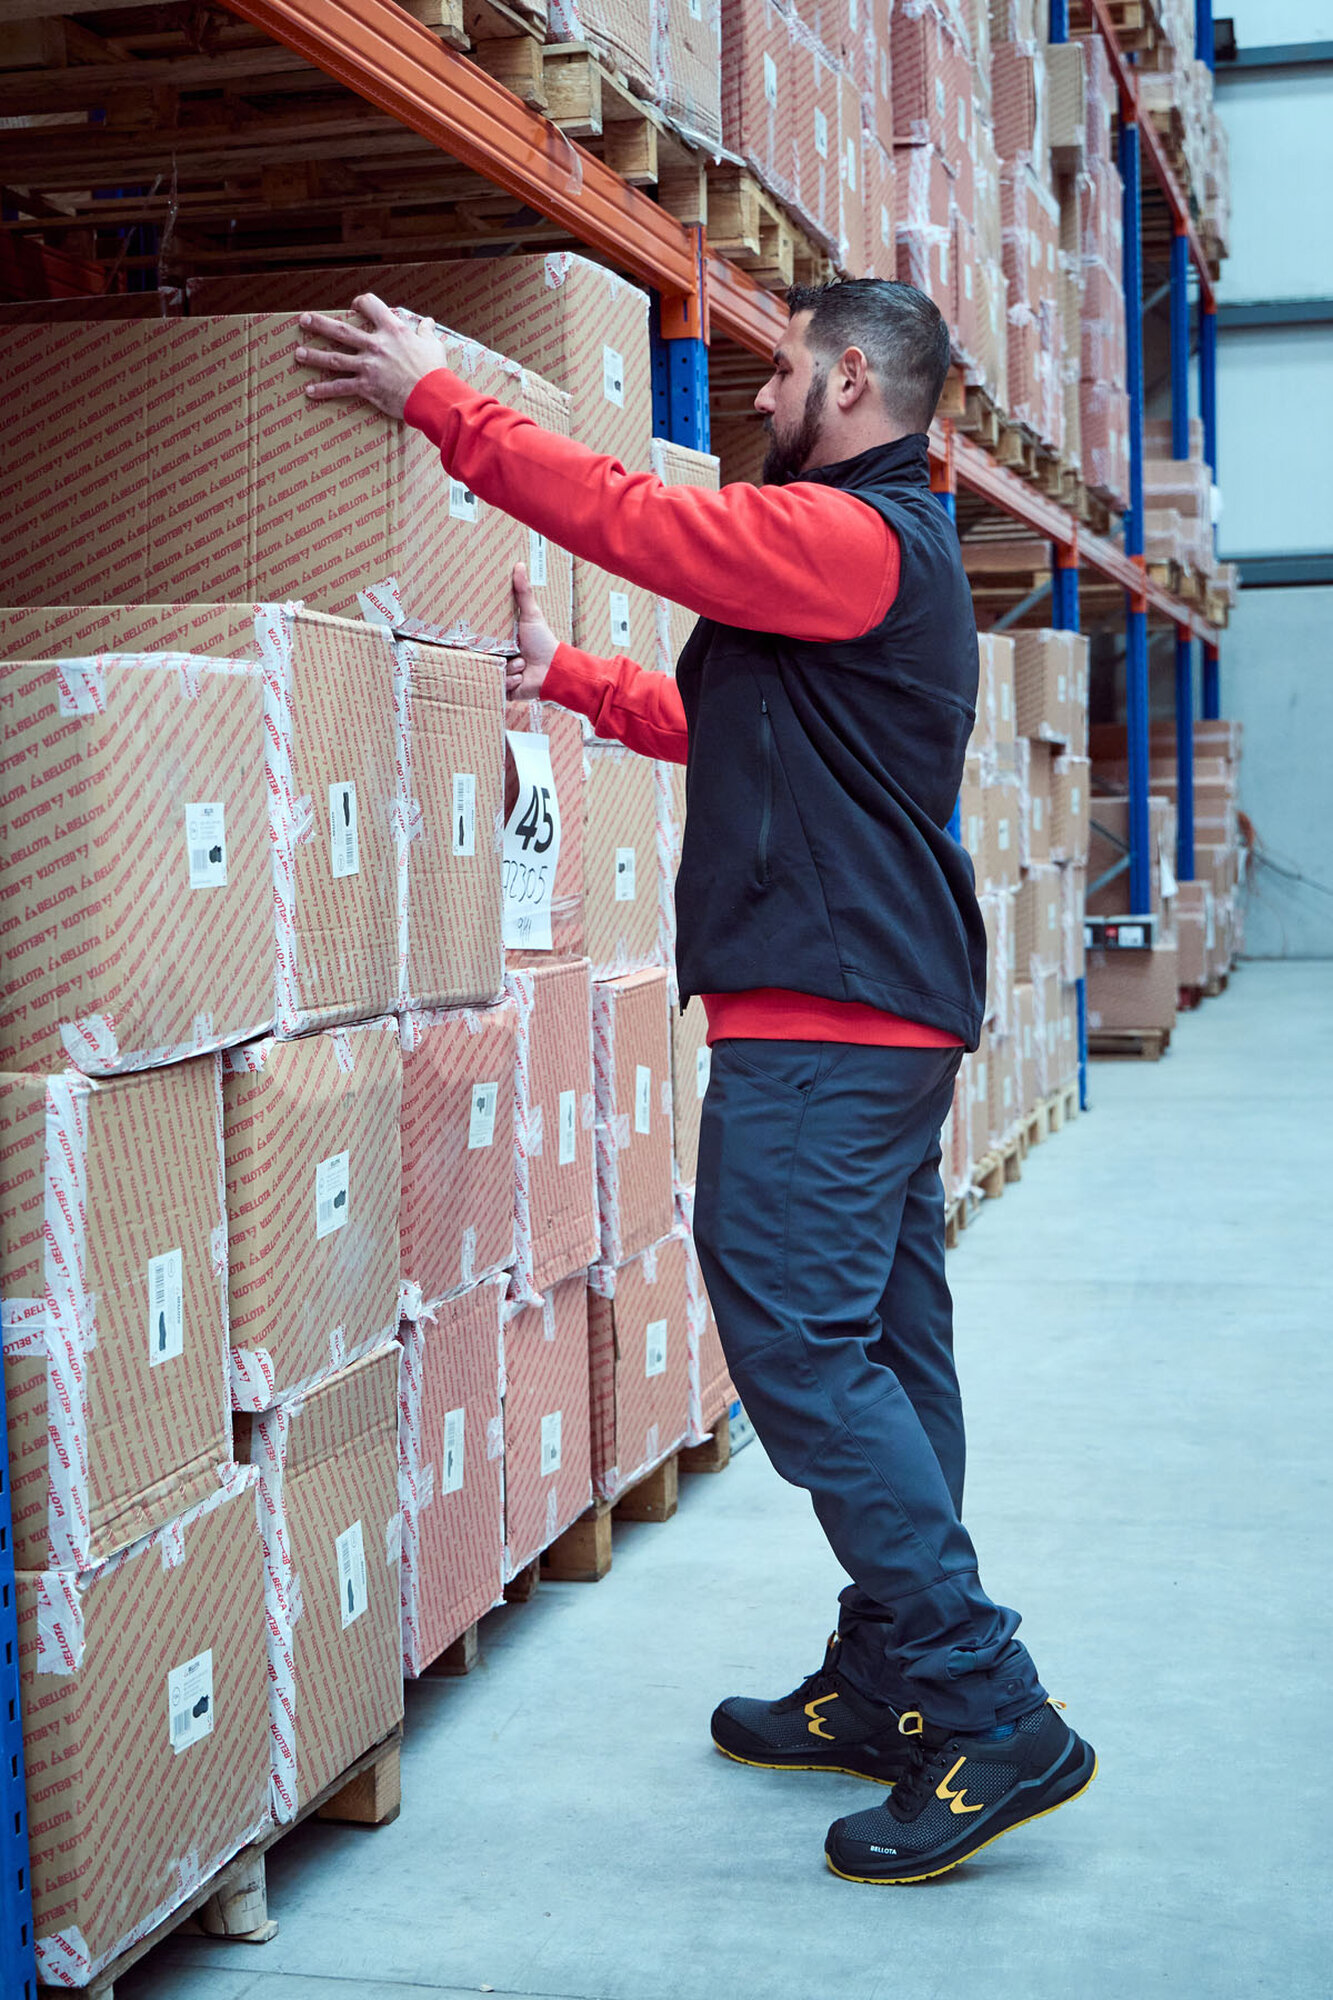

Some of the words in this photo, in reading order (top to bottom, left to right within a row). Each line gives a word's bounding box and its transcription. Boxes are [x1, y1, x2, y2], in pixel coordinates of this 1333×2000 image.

[228, 341, 258, 361] BELLOTA
[227, 367, 257, 387] BELLOTA
[245, 379, 275, 399] BELLOTA
[244, 404, 274, 425] BELLOTA
[262, 417, 291, 437] BELLOTA
[261, 442, 291, 463] BELLOTA
[303, 418, 334, 438] BELLOTA
[237, 479, 266, 499] BELLOTA
[279, 455, 308, 475] BELLOTA
[322, 430, 351, 450] BELLOTA
[278, 480, 308, 501] BELLOTA
[320, 456, 351, 476] BELLOTA
[254, 517, 283, 537] BELLOTA
[296, 493, 325, 513] BELLOTA
[339, 468, 368, 488] BELLOTA
[252, 542, 283, 563] BELLOTA
[295, 518, 325, 539] BELLOTA
[337, 494, 368, 514] BELLOTA
[270, 555, 300, 575] BELLOTA
[313, 531, 342, 551] BELLOTA
[356, 507, 385, 527] BELLOTA
[269, 580, 300, 600] BELLOTA
[312, 556, 342, 577] BELLOTA
[354, 532, 385, 552] BELLOTA
[330, 569, 359, 589] BELLOTA
[366, 592, 394, 622] BELLOTA
[123, 616, 158, 641] BELLOTA
[42, 719, 82, 748] BELLOTA
[42, 753, 84, 782] BELLOTA
[66, 769, 105, 798] BELLOTA
[515, 785, 554, 854] 45
[10, 836, 52, 864] BELLOTA
[35, 851, 77, 880] BELLOTA
[37, 885, 78, 914] BELLOTA
[61, 901, 103, 930] BELLOTA
[60, 936, 102, 964] BELLOTA
[30, 982, 71, 1010] BELLOTA
[240, 1158, 272, 1186] BELLOTA
[55, 1190, 75, 1235] BELLOTA
[239, 1189, 271, 1217] BELLOTA
[232, 1275, 267, 1300] BELLOTA
[231, 1305, 266, 1330] BELLOTA
[64, 1340, 82, 1384] BELLOTA
[48, 1425, 71, 1470] BELLOTA
[258, 1422, 276, 1461] BELLOTA
[53, 1622, 76, 1668] BELLOTA
[36, 1682, 79, 1709] BELLOTA
[270, 1722, 292, 1760] BELLOTA
[31, 1777, 72, 1803] BELLOTA
[272, 1774, 292, 1811] BELLOTA
[33, 1810, 73, 1837] BELLOTA
[870, 1845, 898, 1856] BELLOTA
